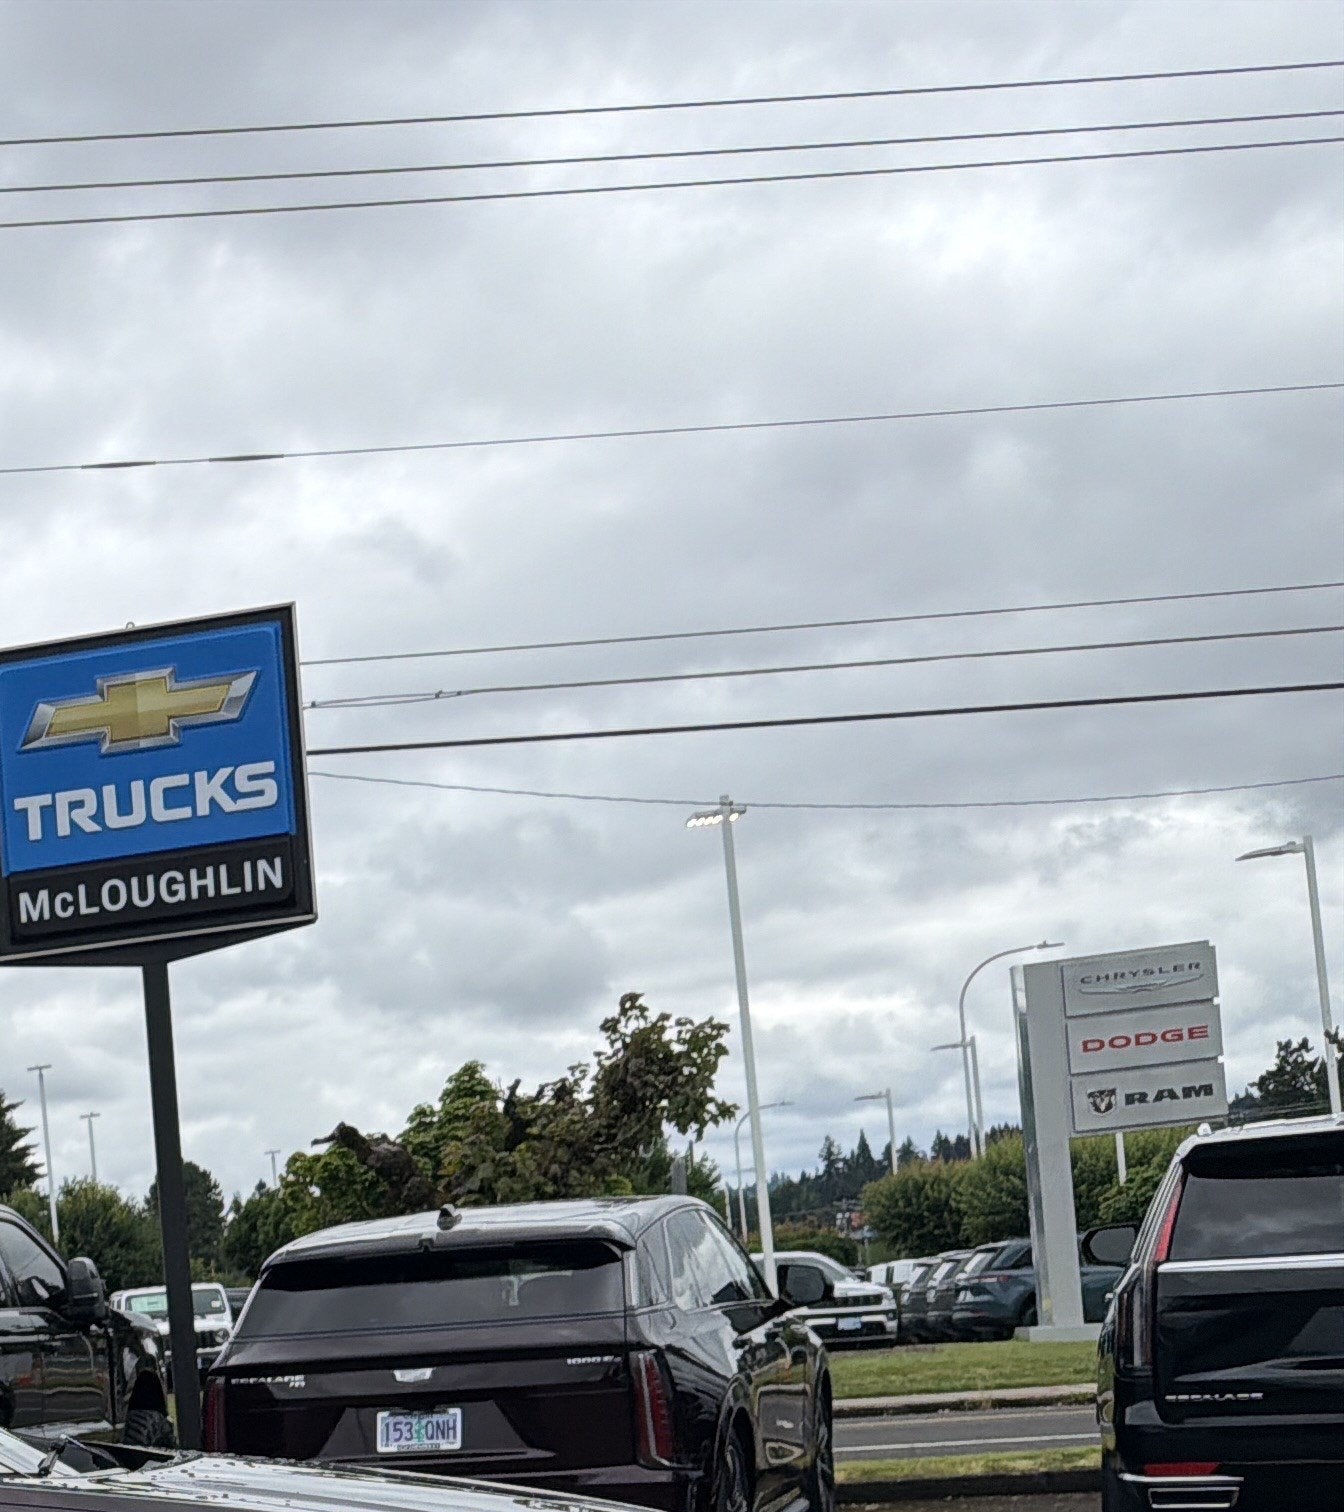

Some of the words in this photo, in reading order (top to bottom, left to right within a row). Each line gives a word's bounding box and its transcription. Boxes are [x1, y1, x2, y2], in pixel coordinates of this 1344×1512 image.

[14, 761, 278, 841] TRUCKS
[18, 856, 283, 924] McLOUGHLIN
[1080, 961, 1202, 985] CHRYSLER
[1082, 1024, 1209, 1053] DODGE
[1124, 1083, 1214, 1106] RAM
